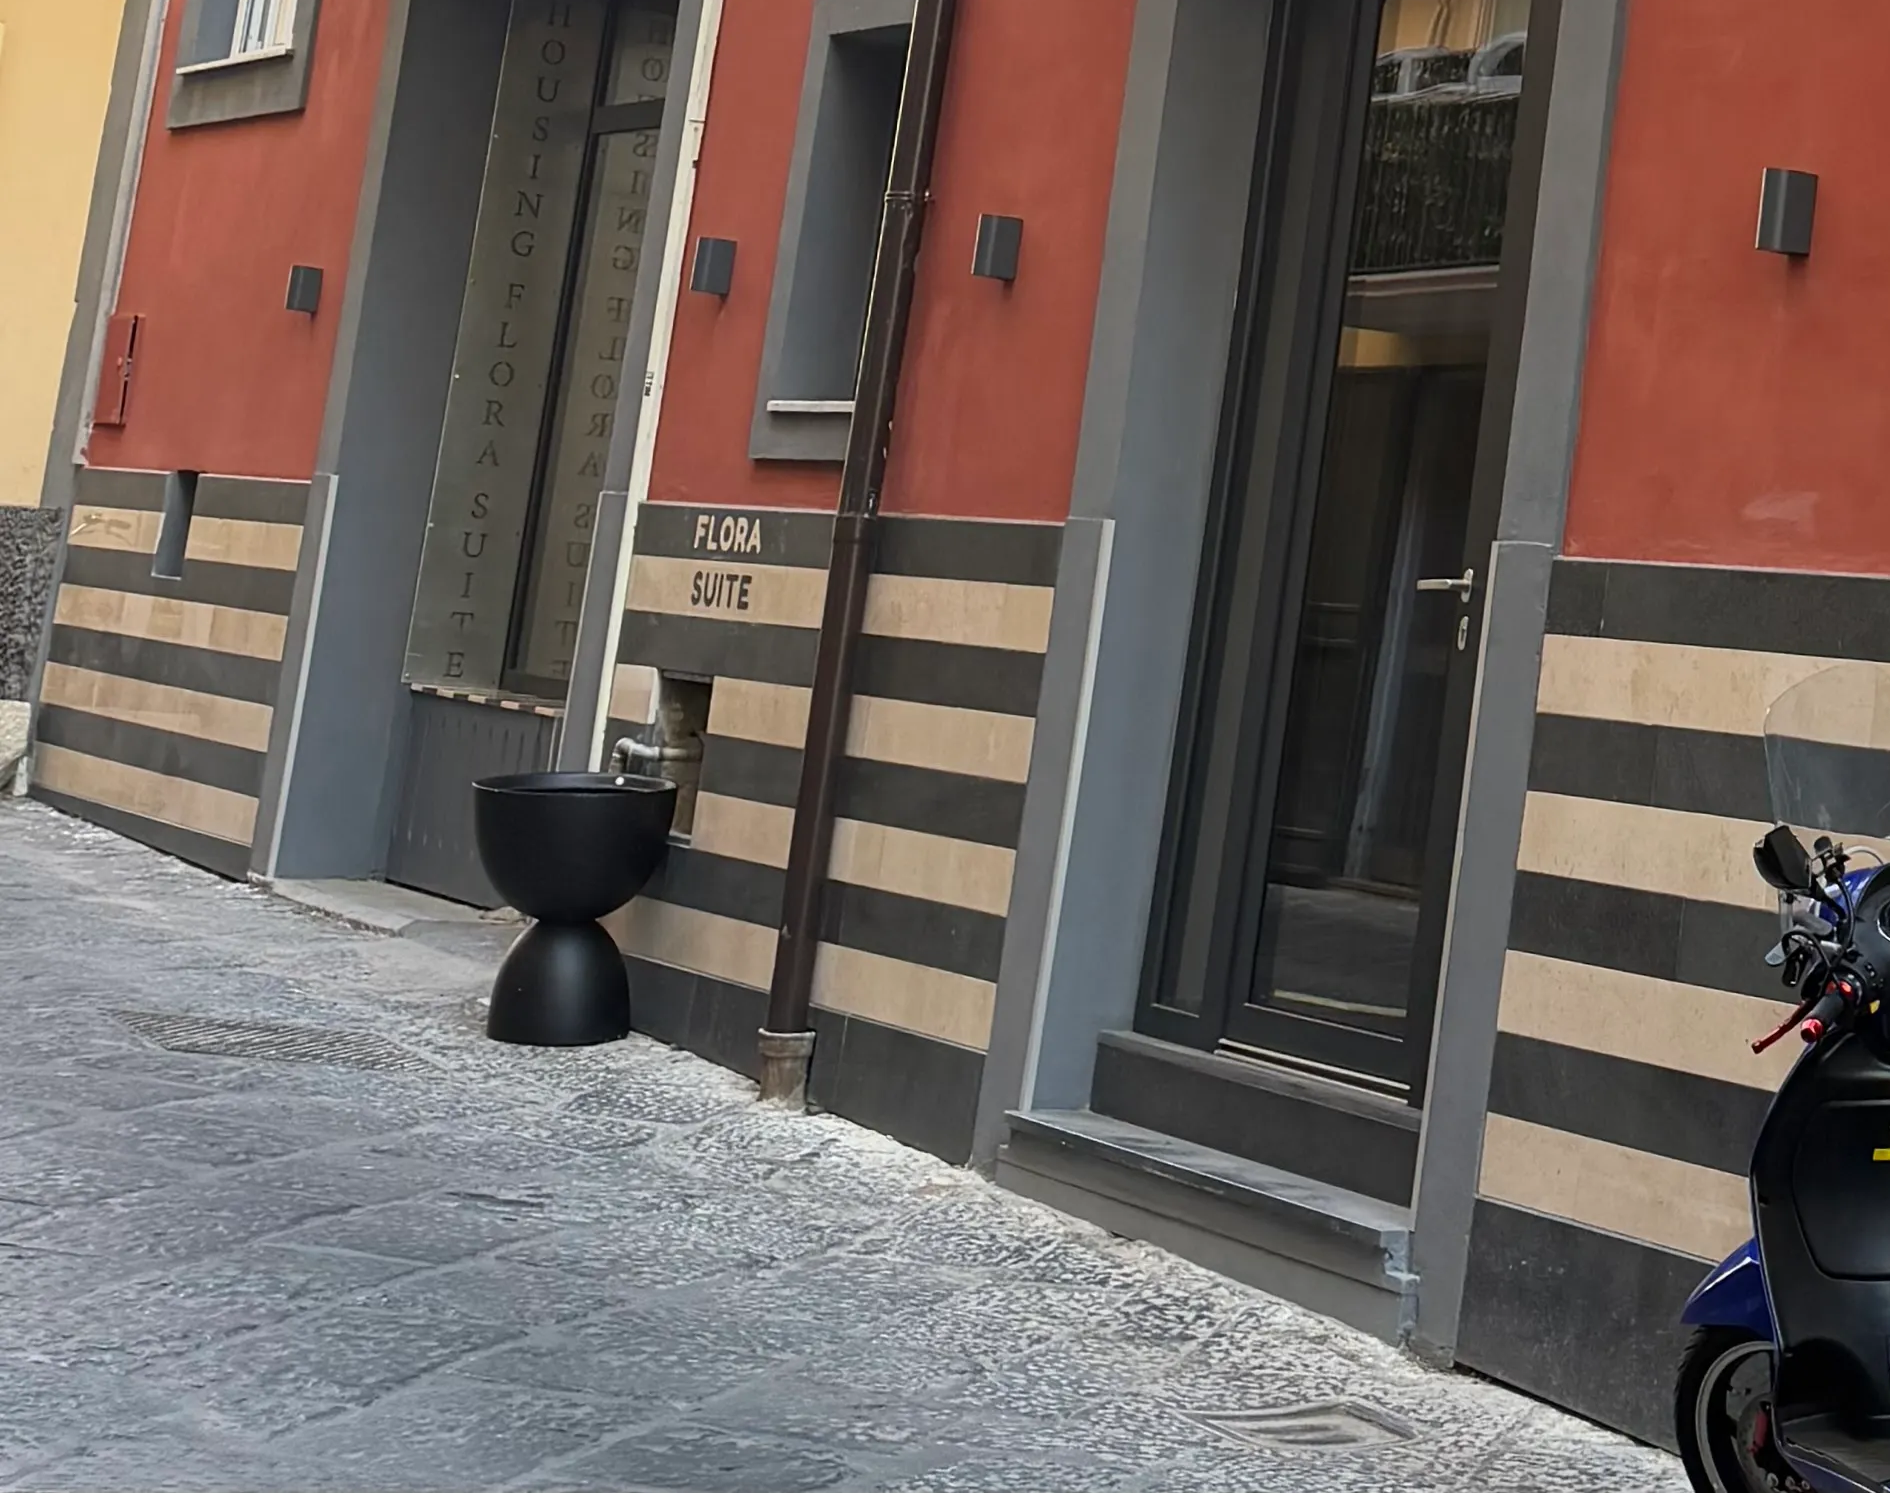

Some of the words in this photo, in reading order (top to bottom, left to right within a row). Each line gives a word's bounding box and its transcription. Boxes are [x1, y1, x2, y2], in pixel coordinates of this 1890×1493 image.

[509, 1, 573, 258] HOUSING
[476, 283, 525, 467] FLORA
[443, 493, 489, 678] SUITE
[691, 571, 752, 610] SUITE
[694, 514, 761, 554] FLORA
